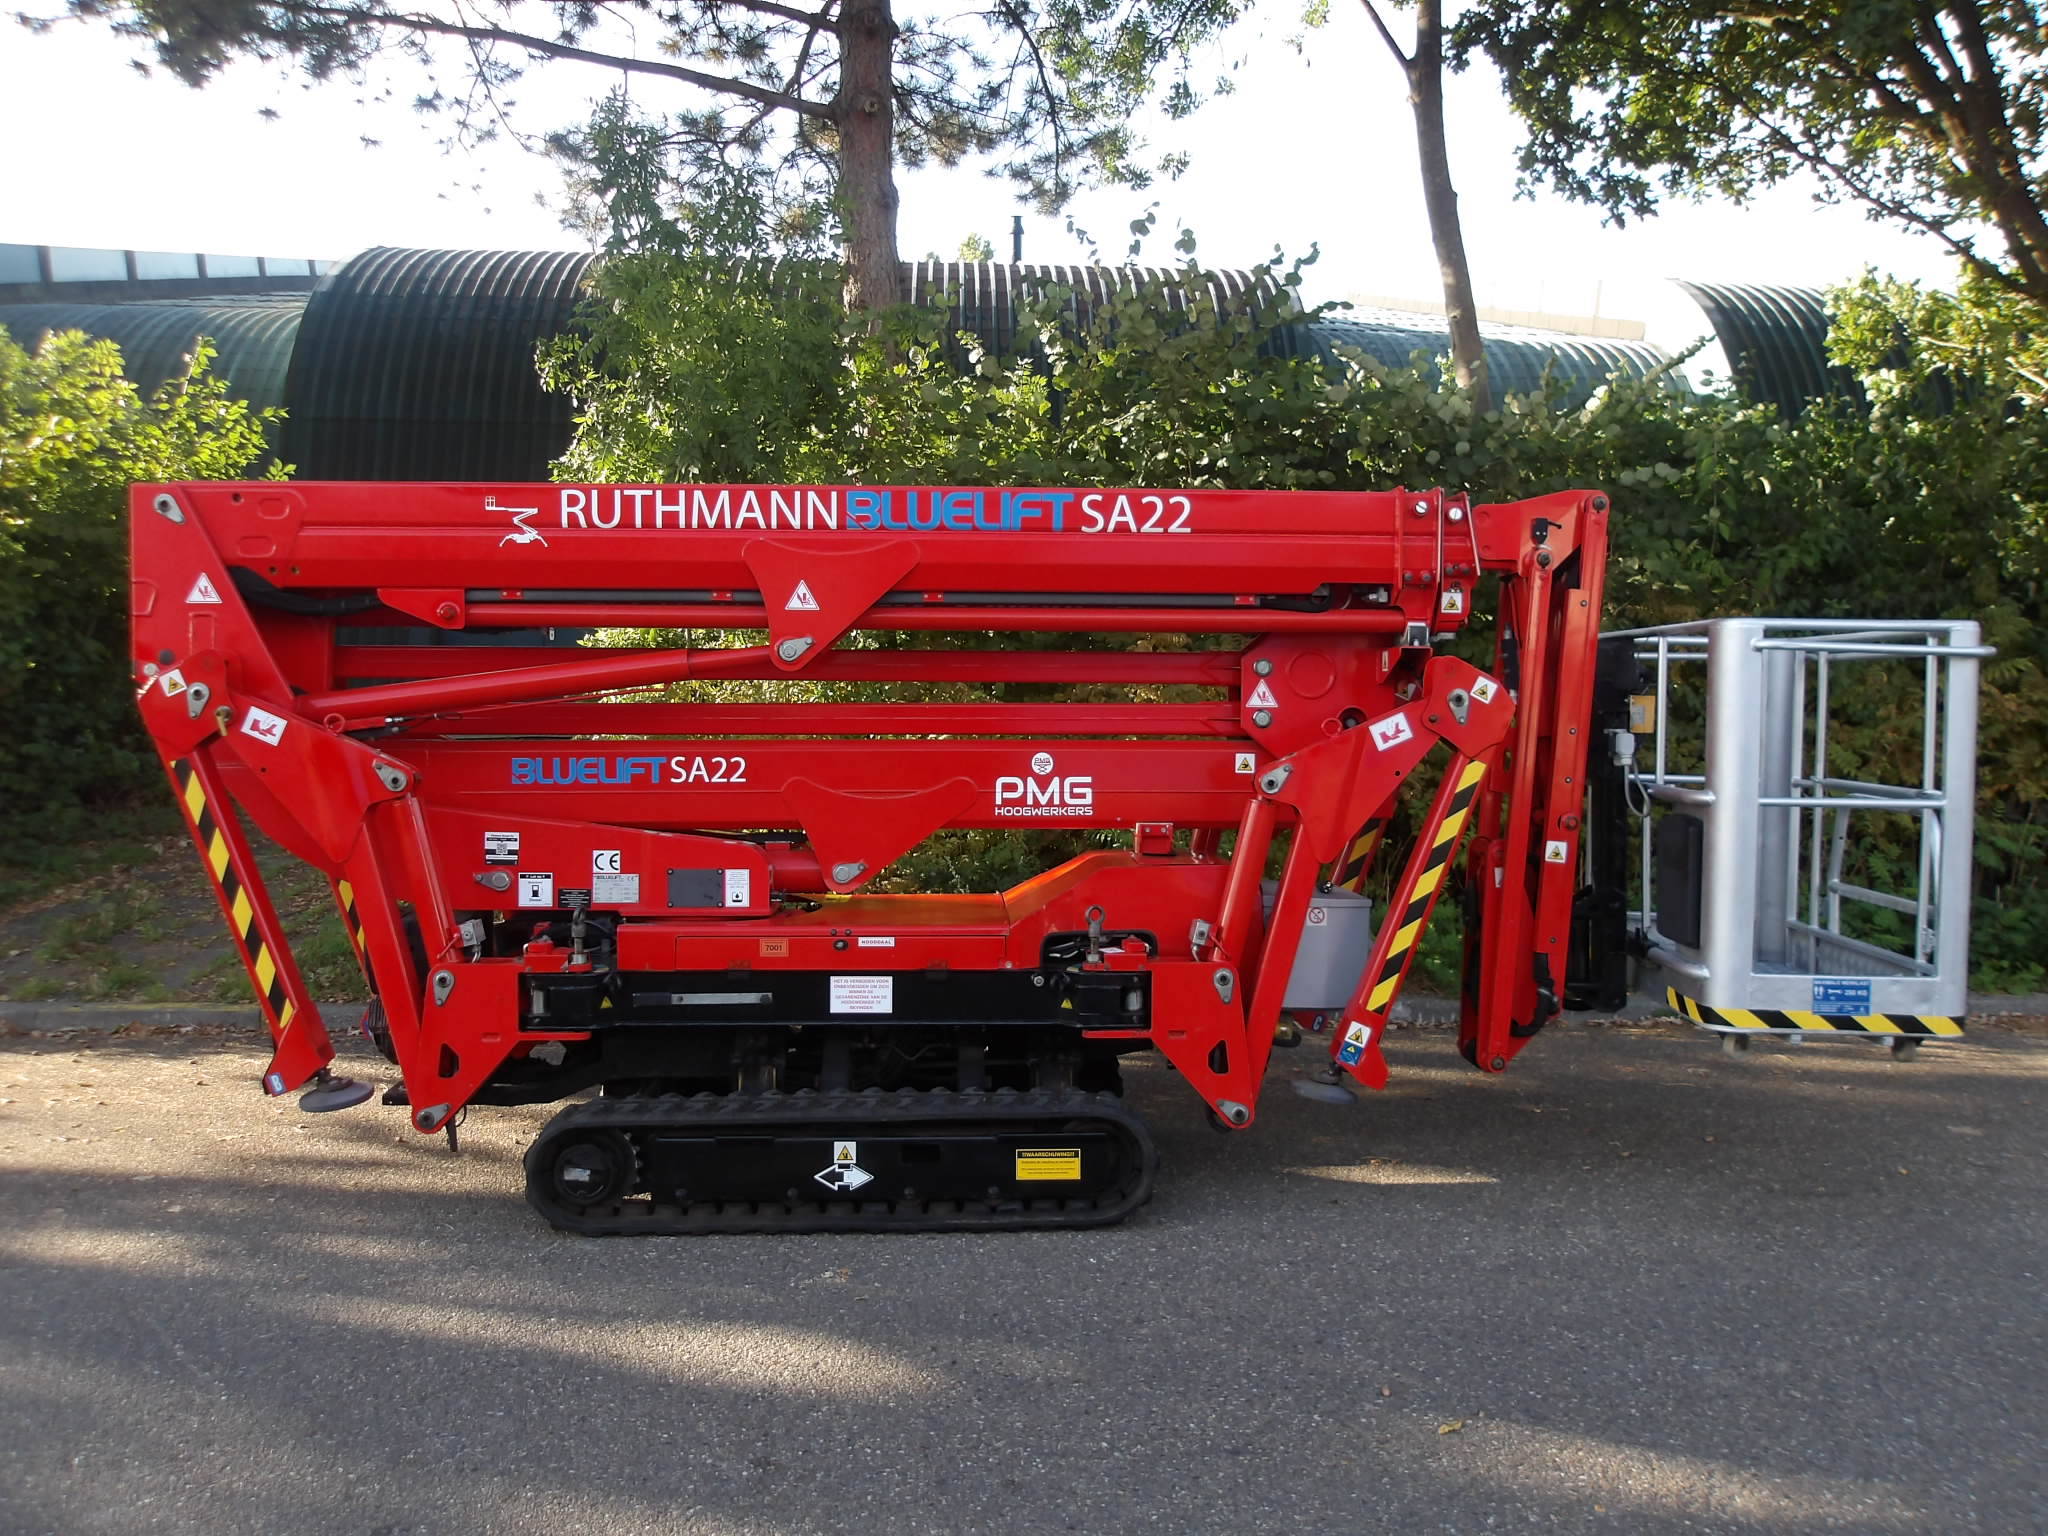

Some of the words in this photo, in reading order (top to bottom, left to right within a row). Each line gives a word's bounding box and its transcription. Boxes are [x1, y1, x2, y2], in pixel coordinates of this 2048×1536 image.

[560, 488, 839, 530] RUTHMANN
[846, 490, 1074, 532] BLUELIFT
[1080, 494, 1193, 534] SA22
[511, 757, 667, 784] BLUELIFT
[670, 755, 747, 784] SA22
[995, 776, 1093, 806] PMG
[995, 806, 1093, 817] HOOGWERKERS
[594, 852, 620, 871] CE
[765, 944, 783, 952] 7001
